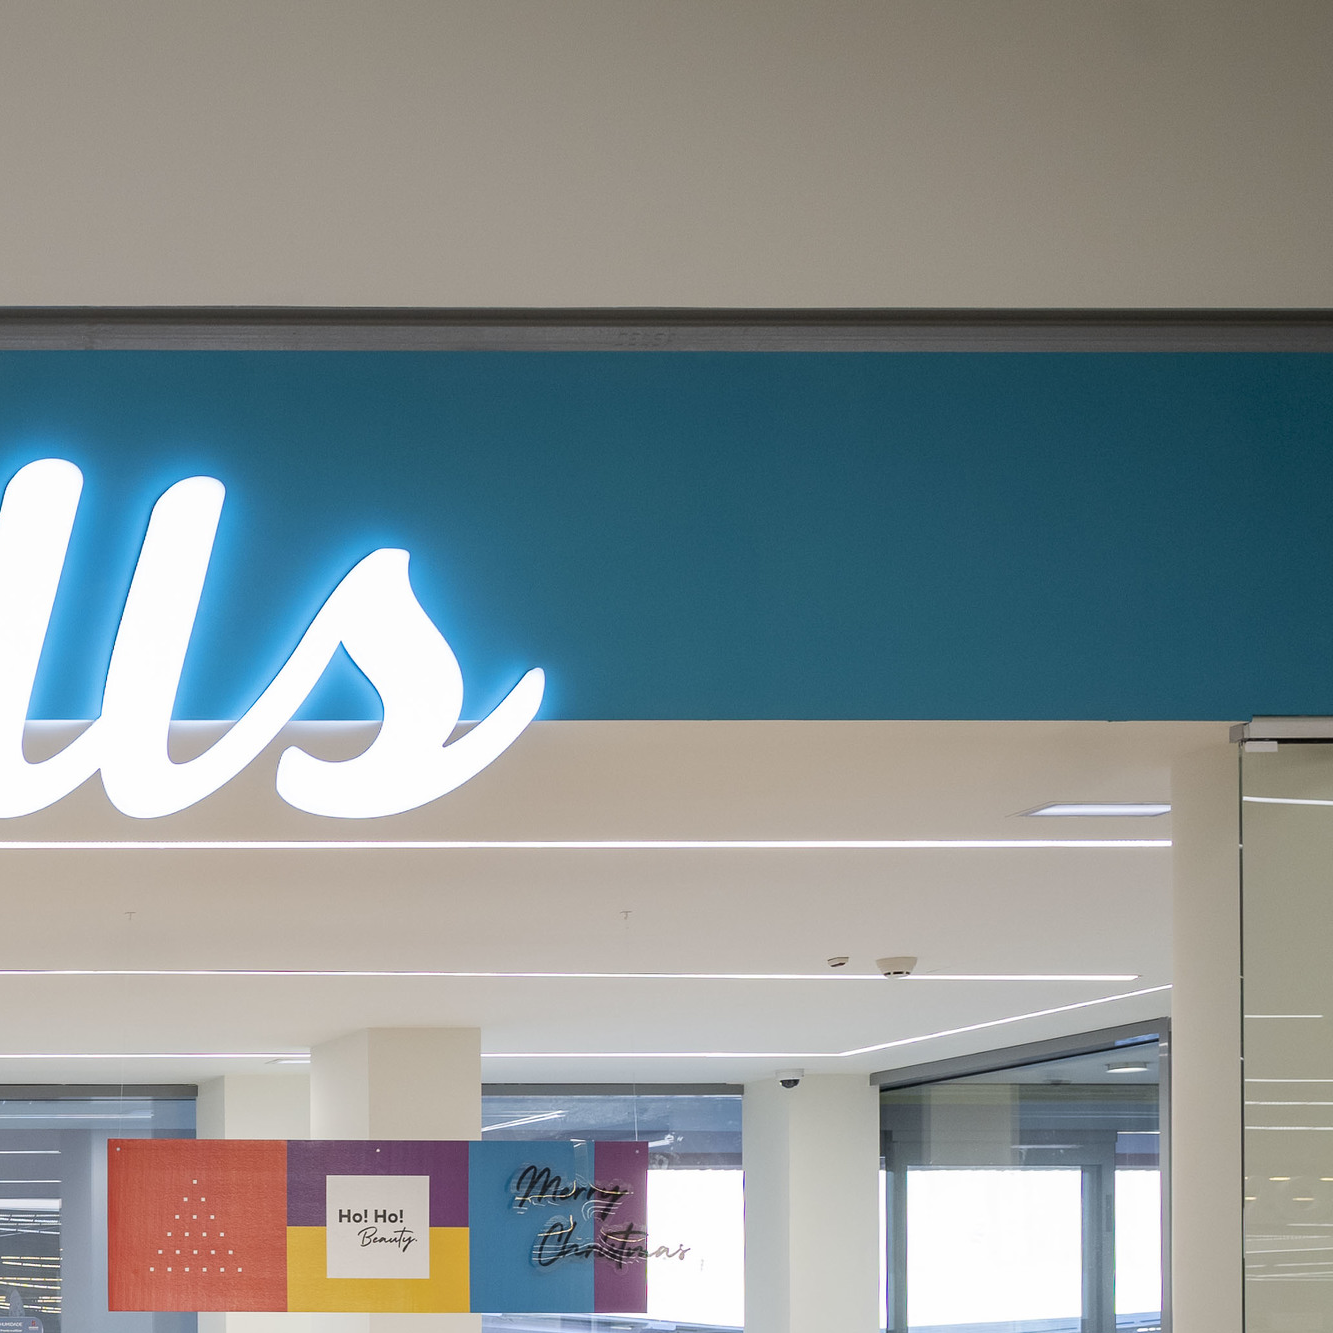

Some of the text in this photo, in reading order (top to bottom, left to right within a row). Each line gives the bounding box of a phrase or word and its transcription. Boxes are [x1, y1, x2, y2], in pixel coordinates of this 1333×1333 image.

[515, 1164, 629, 1222] Merry
[338, 1208, 404, 1224] Ho! Ho!
